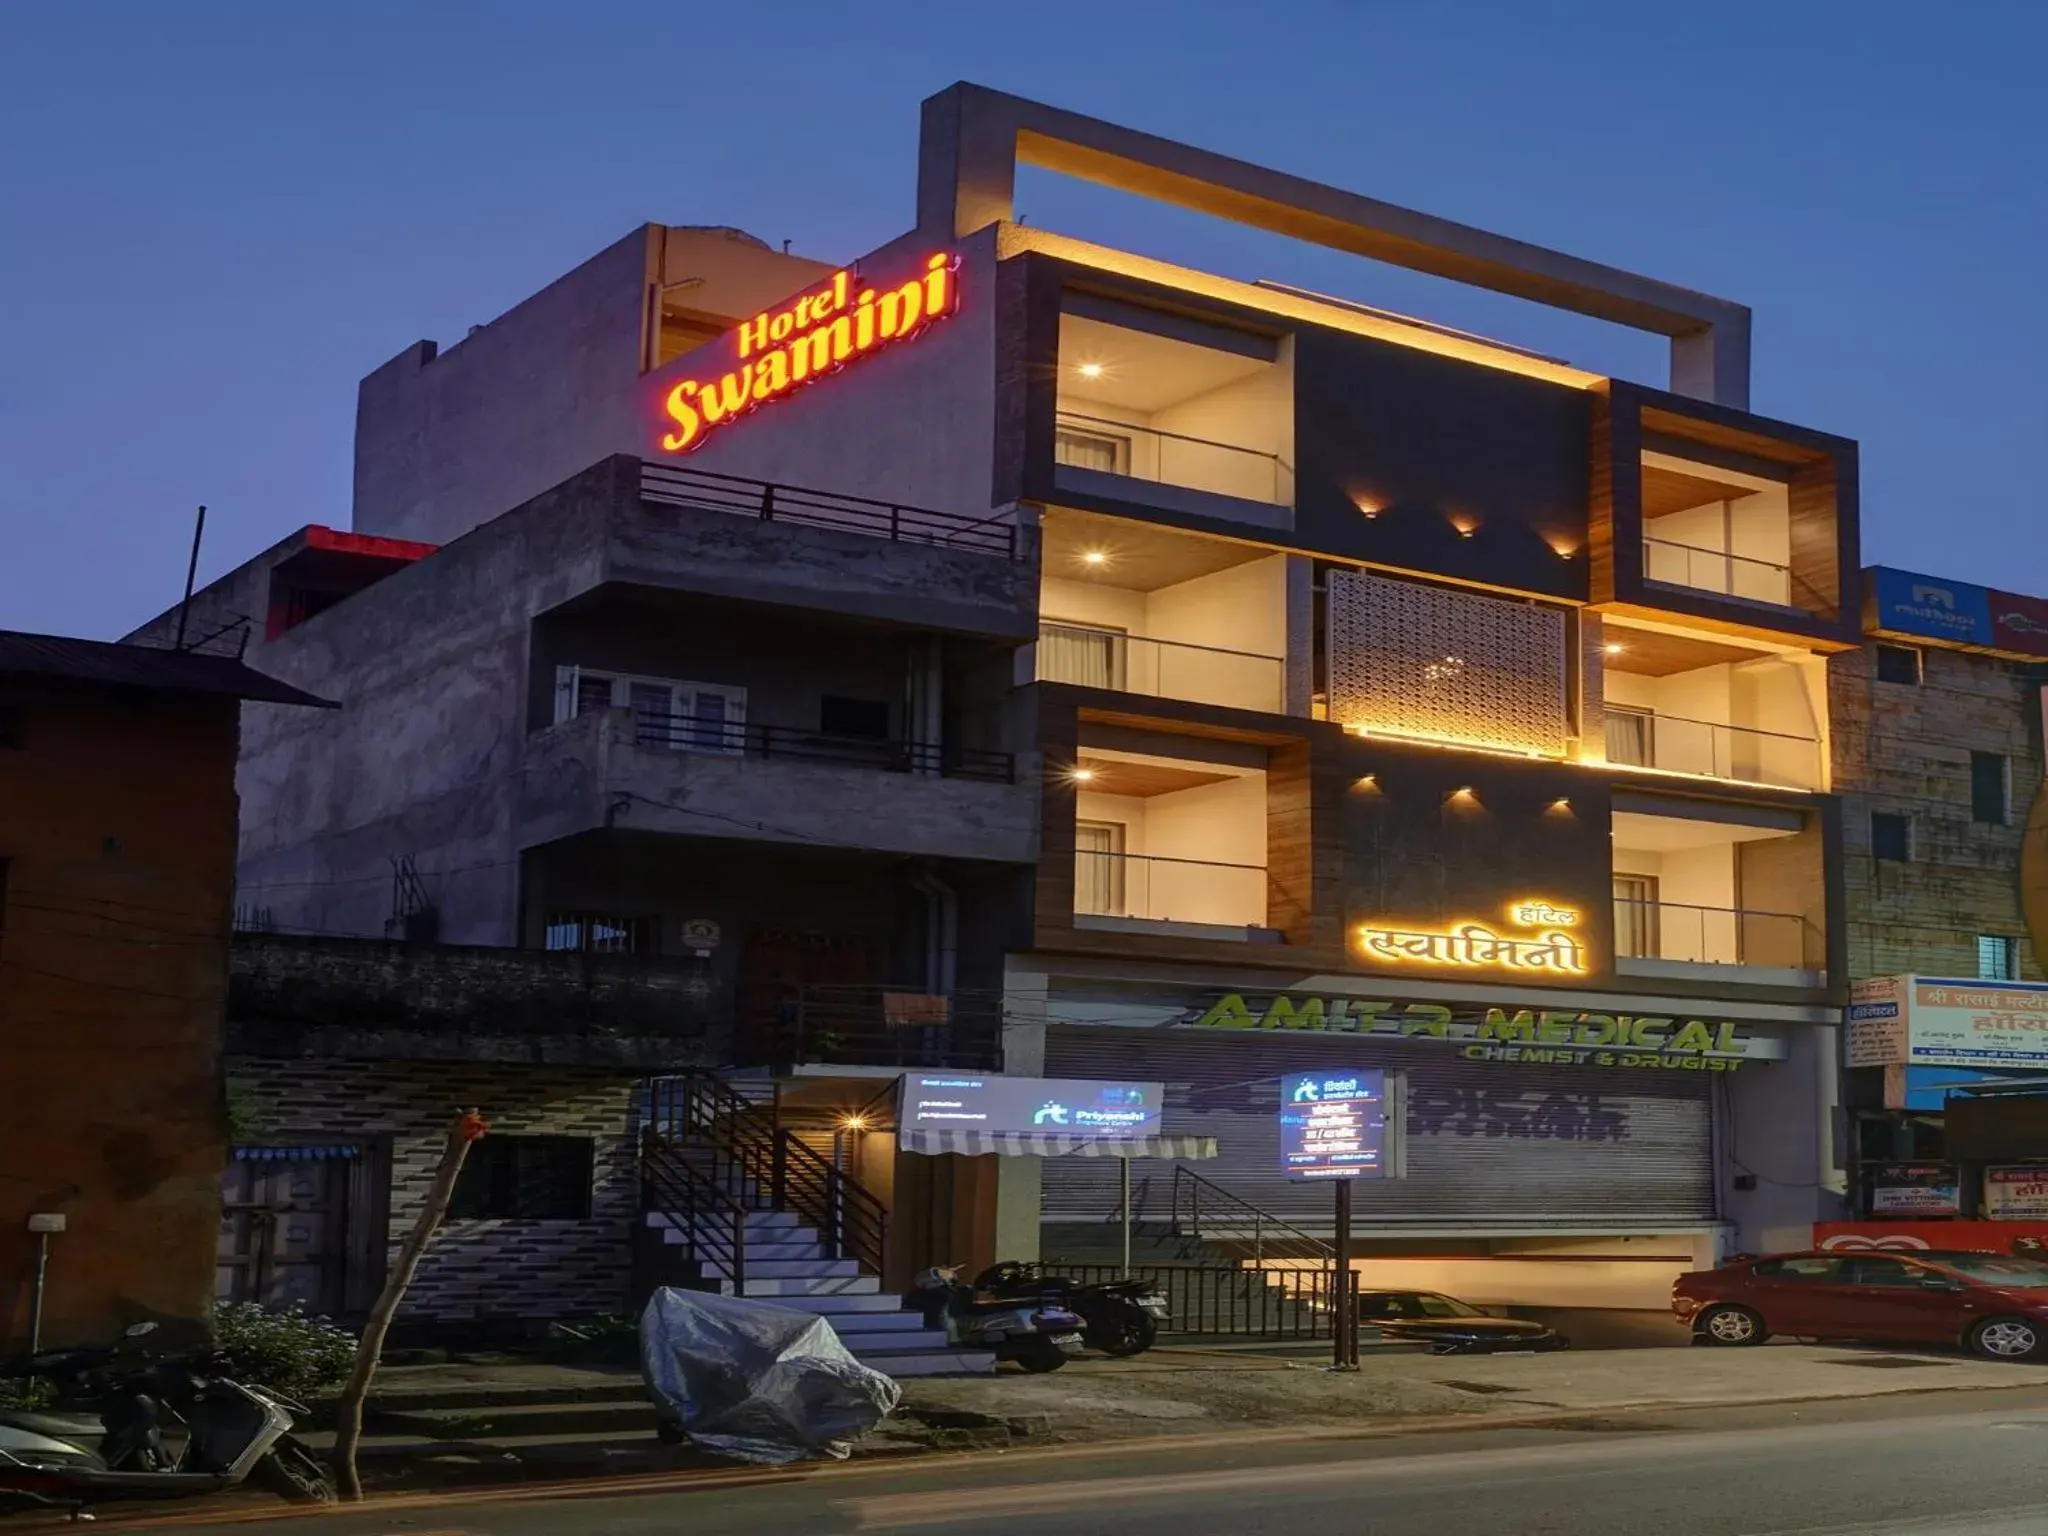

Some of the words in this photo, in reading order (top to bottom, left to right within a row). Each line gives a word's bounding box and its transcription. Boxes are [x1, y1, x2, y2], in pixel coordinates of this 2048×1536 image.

[738, 271, 848, 359] Hotel
[662, 252, 949, 451] Swamini
[1363, 925, 1587, 971] स्वामिनी
[1477, 1007, 1750, 1054] MEDICAL
[1462, 1045, 1591, 1065] CHEMIST
[1596, 1051, 1616, 1067] &
[1618, 1053, 1746, 1072] DRUGIST
